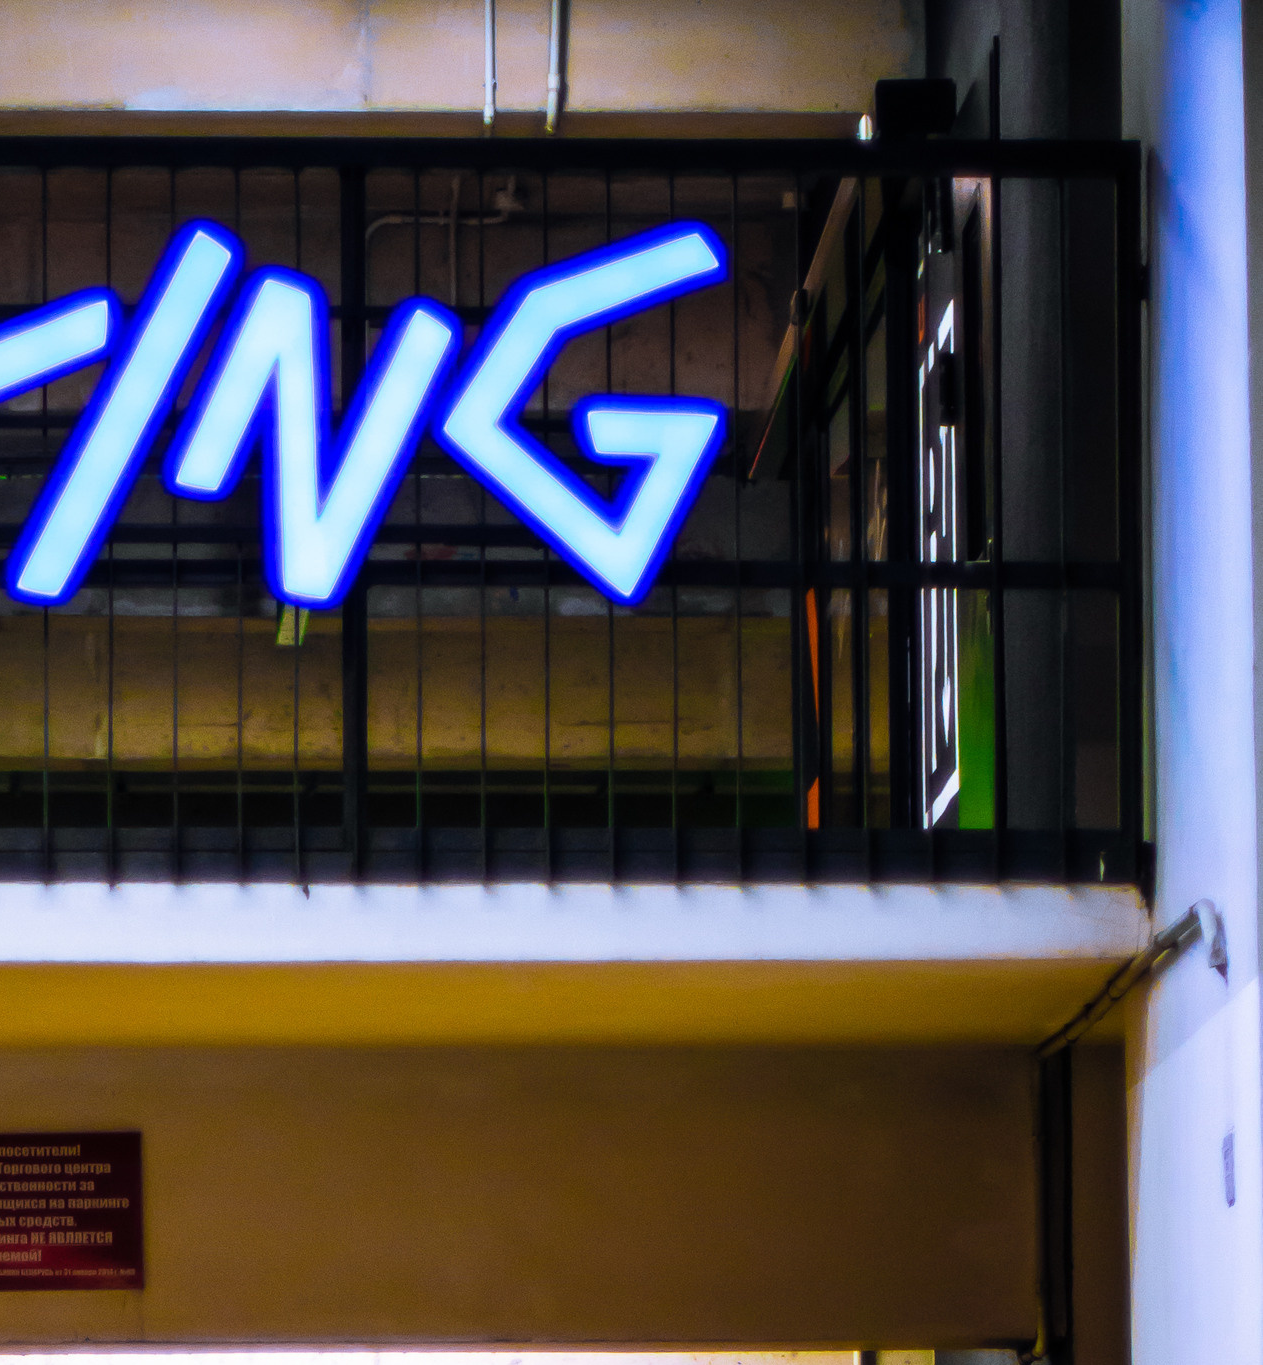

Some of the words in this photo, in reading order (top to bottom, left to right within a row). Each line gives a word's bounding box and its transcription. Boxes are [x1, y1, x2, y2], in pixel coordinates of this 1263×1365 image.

[64, 1162, 112, 1176] центра
[79, 1180, 95, 1191] за
[49, 1199, 65, 1209] на
[68, 1198, 130, 1210] паркинге
[30, 1232, 46, 1244] НЕ
[48, 1231, 113, 1244] ЯВЛЯЕТСЯ
